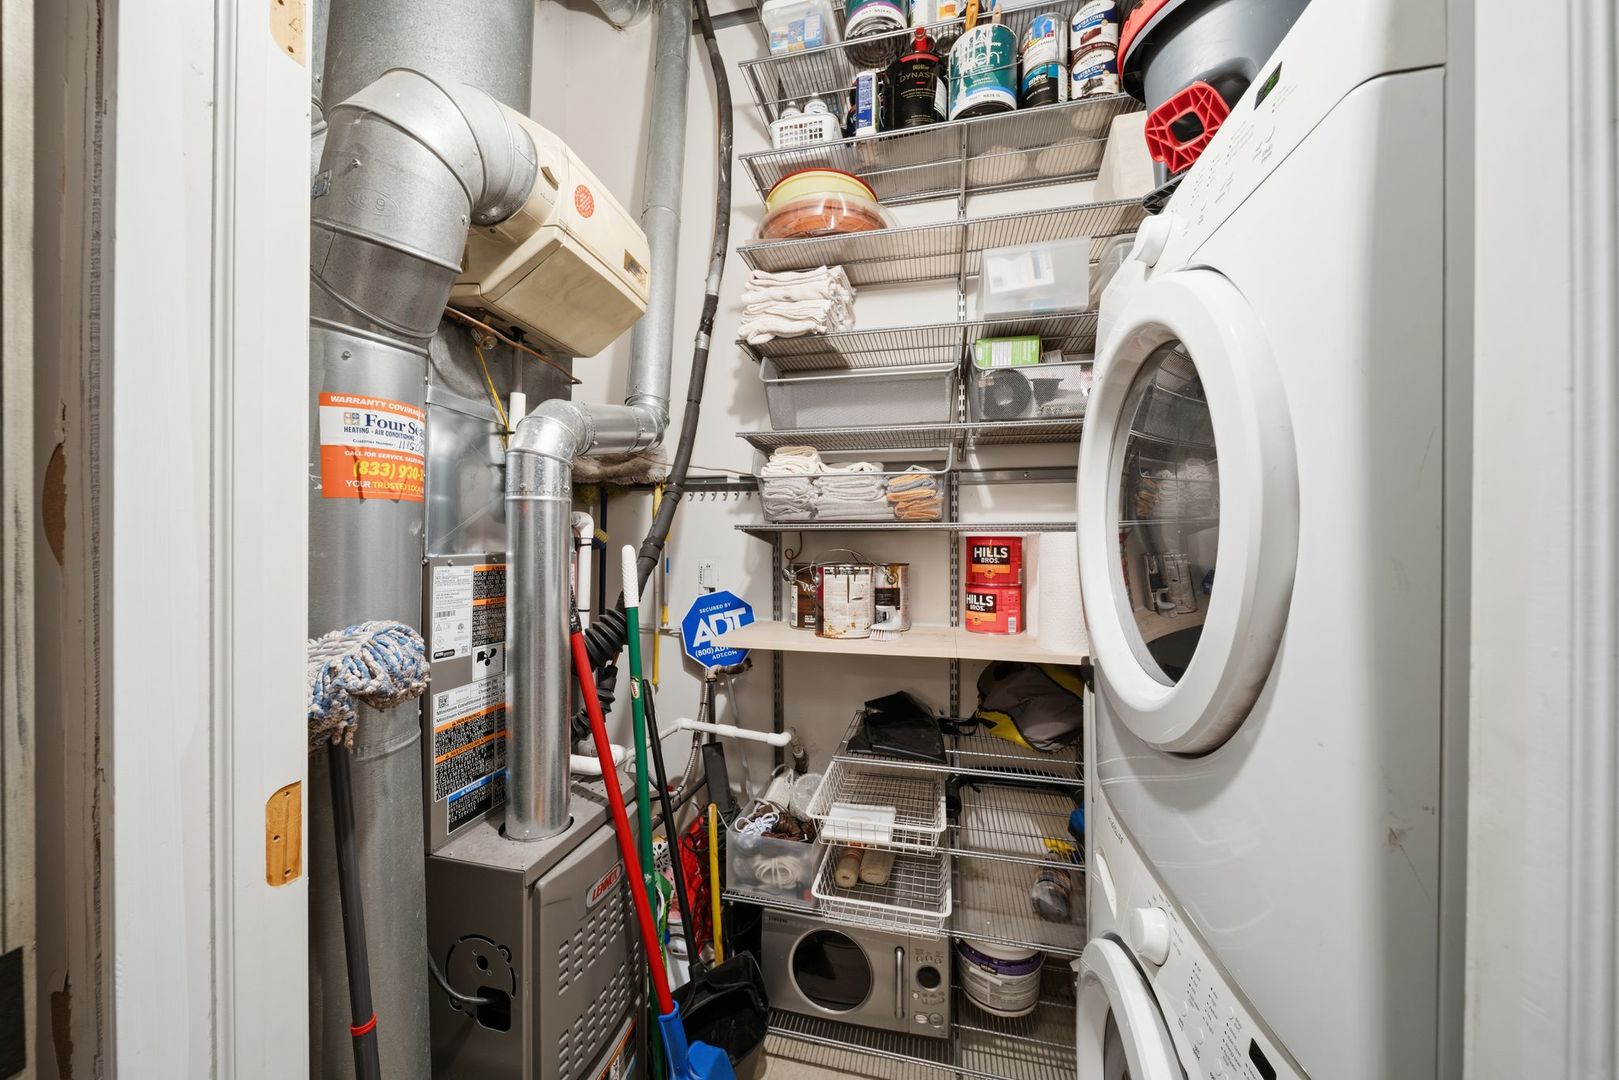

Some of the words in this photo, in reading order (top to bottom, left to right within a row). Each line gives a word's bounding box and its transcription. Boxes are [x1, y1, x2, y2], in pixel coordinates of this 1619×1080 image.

[330, 395, 387, 408] WARRANTY
[364, 413, 406, 432] Four
[343, 426, 370, 435] HEATING
[374, 429, 385, 437] AIR
[353, 460, 397, 480] (833)
[345, 480, 371, 489] YOUR
[973, 547, 1008, 559] HILLS
[966, 593, 994, 607] HILLS
[699, 604, 724, 614] SECURED
[724, 601, 732, 609] BY
[692, 607, 747, 648] ADT
[695, 646, 714, 658] (800)
